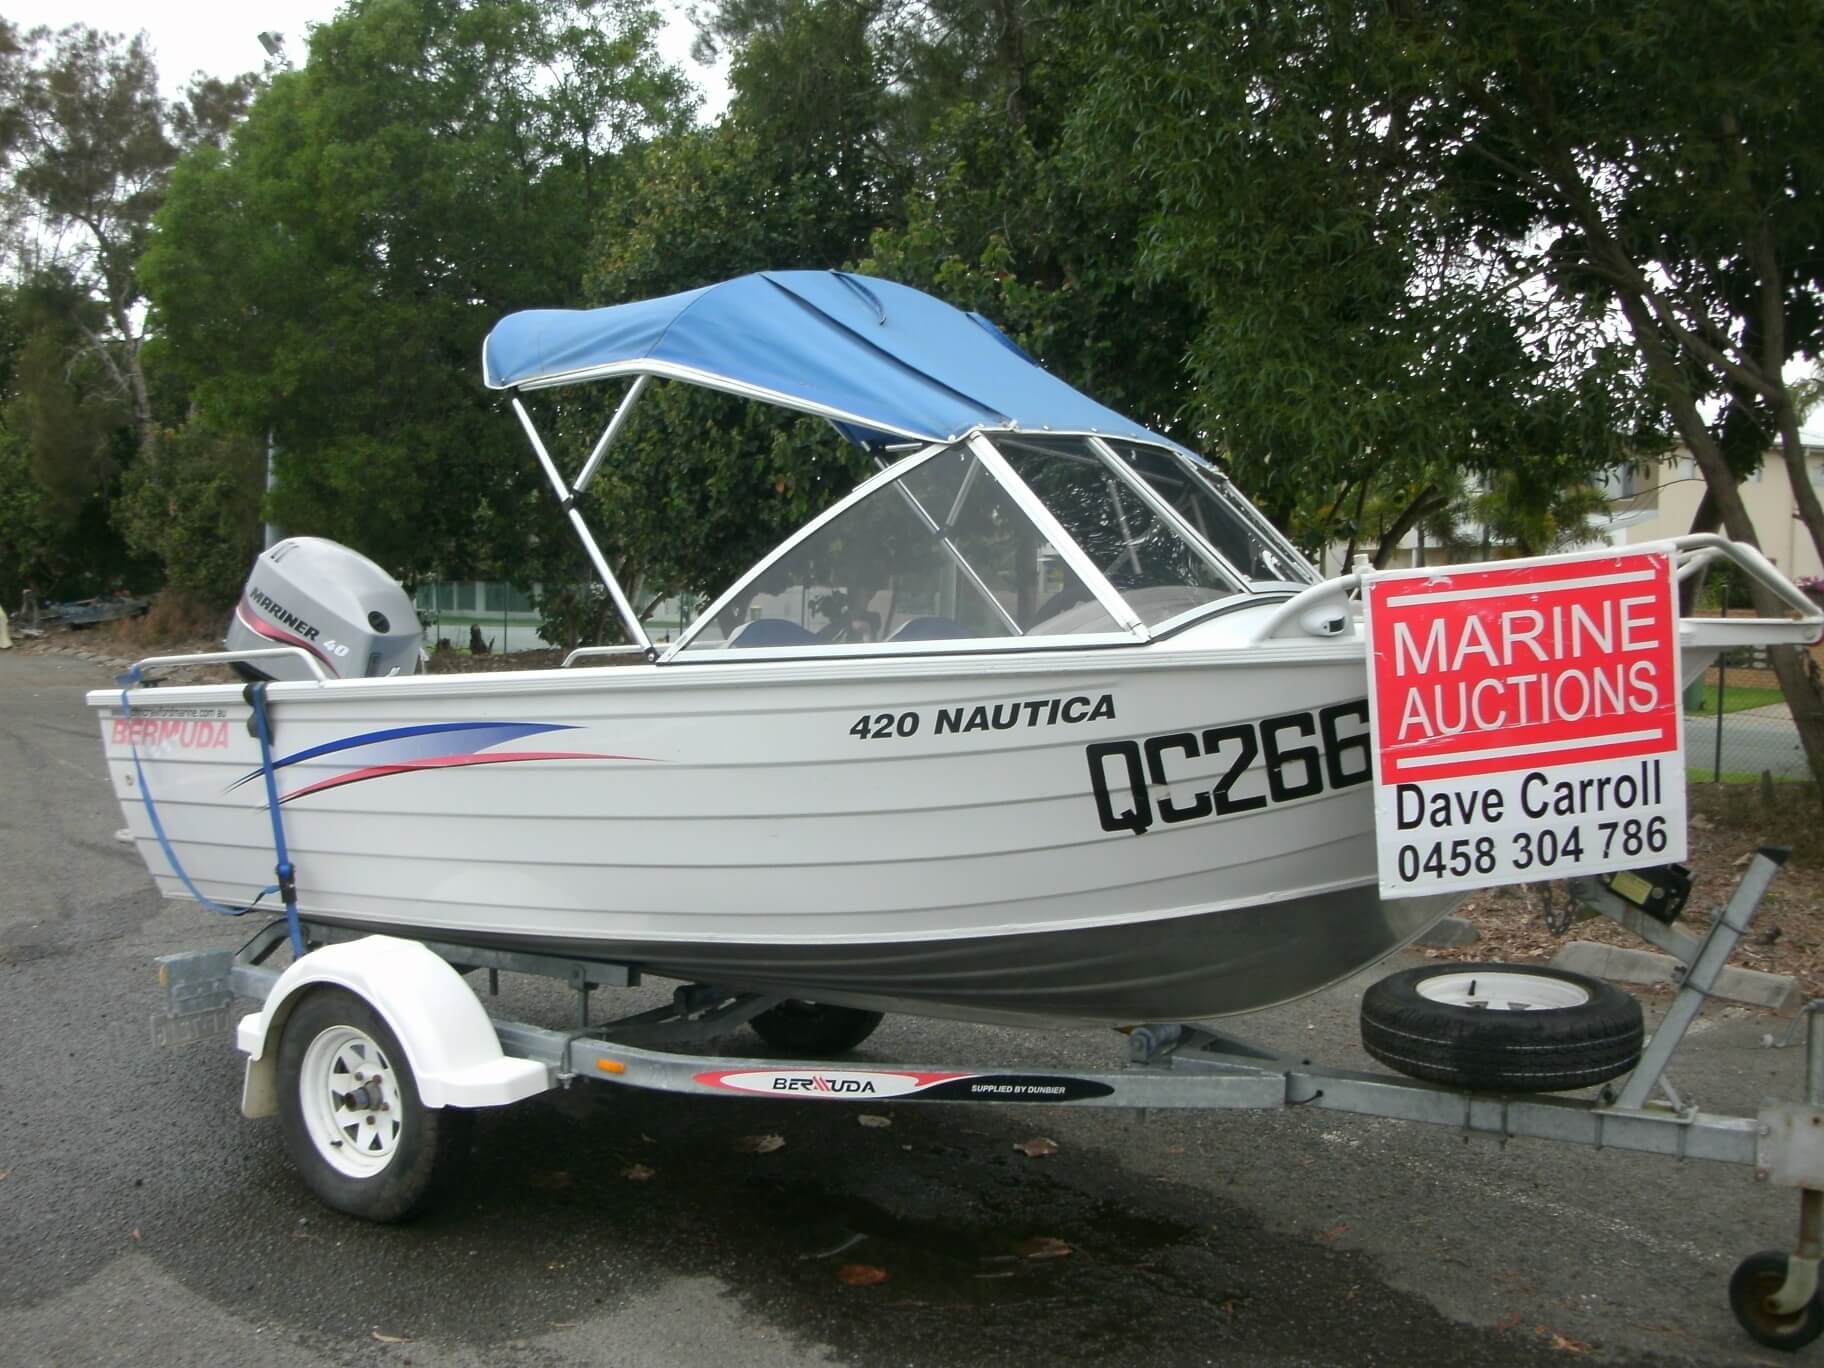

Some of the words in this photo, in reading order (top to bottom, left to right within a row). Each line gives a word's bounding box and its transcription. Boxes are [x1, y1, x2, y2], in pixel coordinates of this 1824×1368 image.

[250, 587, 320, 641] MARINER
[1393, 595, 1660, 677] MARINE
[323, 639, 350, 657] 40
[849, 711, 920, 740] 420
[933, 694, 1117, 735] NAUTICA
[1398, 661, 1660, 740] AUCTIONS
[111, 719, 230, 748] BERMUDA
[1396, 784, 1504, 830] Dave
[1521, 759, 1662, 819] Carroll
[1399, 837, 1496, 882] 0458
[1512, 826, 1584, 870] 304
[1598, 816, 1667, 859] 786
[772, 1076, 876, 1093] BERMUDA
[971, 1084, 1013, 1093] SUPPLIED
[1014, 1085, 1027, 1094] BY
[1027, 1085, 1066, 1095] DUNBIER
